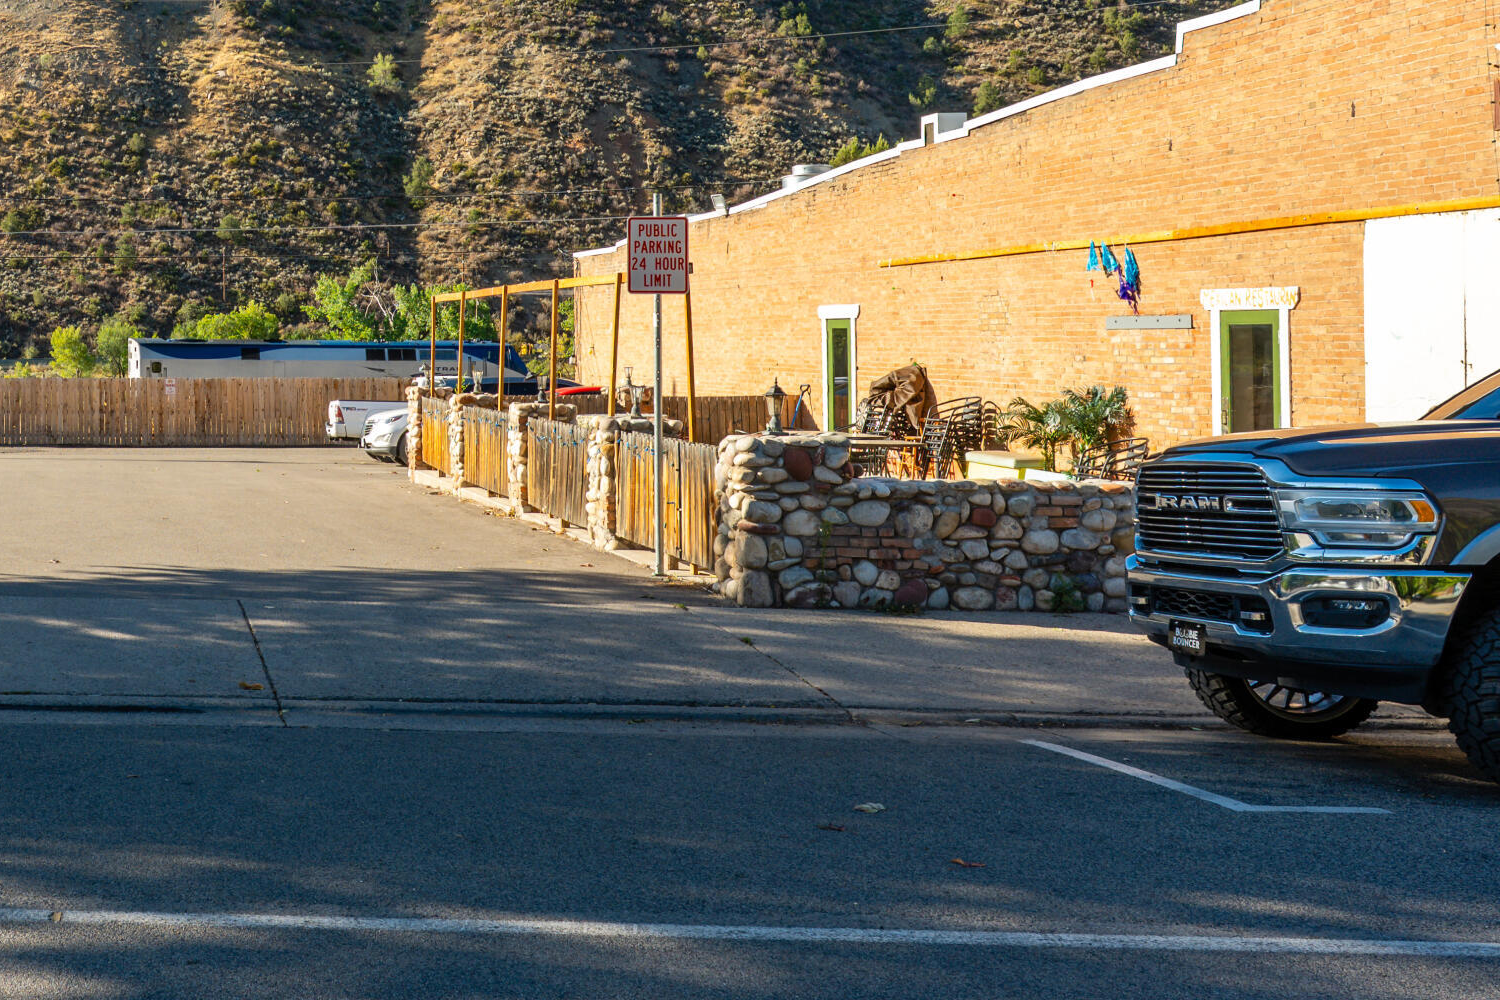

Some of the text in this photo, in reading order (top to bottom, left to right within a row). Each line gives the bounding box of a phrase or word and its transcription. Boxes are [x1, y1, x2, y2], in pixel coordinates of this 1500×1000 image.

[638, 224, 677, 237] PUBLIC
[634, 240, 682, 254] PARKING
[632, 257, 684, 270] 24 HOUR
[643, 274, 672, 287] LIMIT
[1158, 494, 1220, 511] RAM
